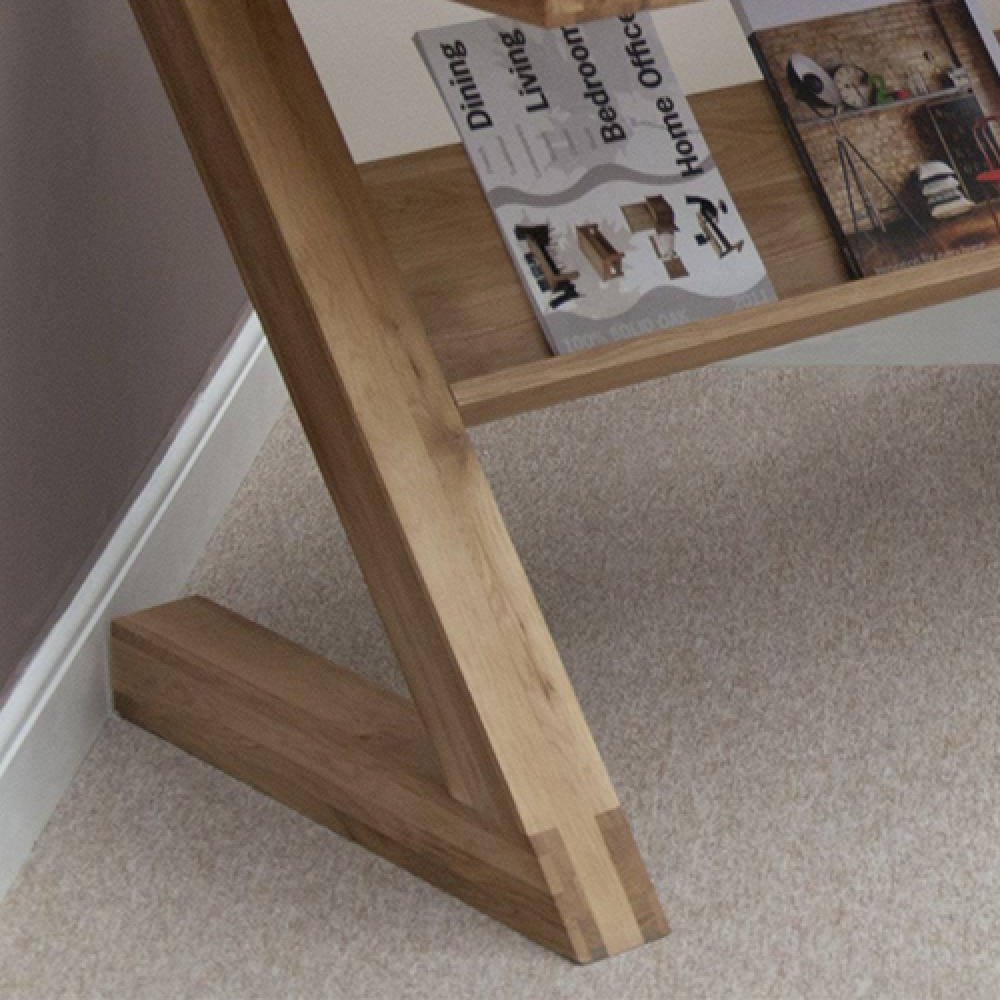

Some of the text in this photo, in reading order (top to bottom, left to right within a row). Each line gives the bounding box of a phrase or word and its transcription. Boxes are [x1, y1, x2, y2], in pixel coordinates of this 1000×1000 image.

[440, 39, 493, 131] Dining
[499, 27, 549, 112] Living
[655, 96, 704, 178] Home
